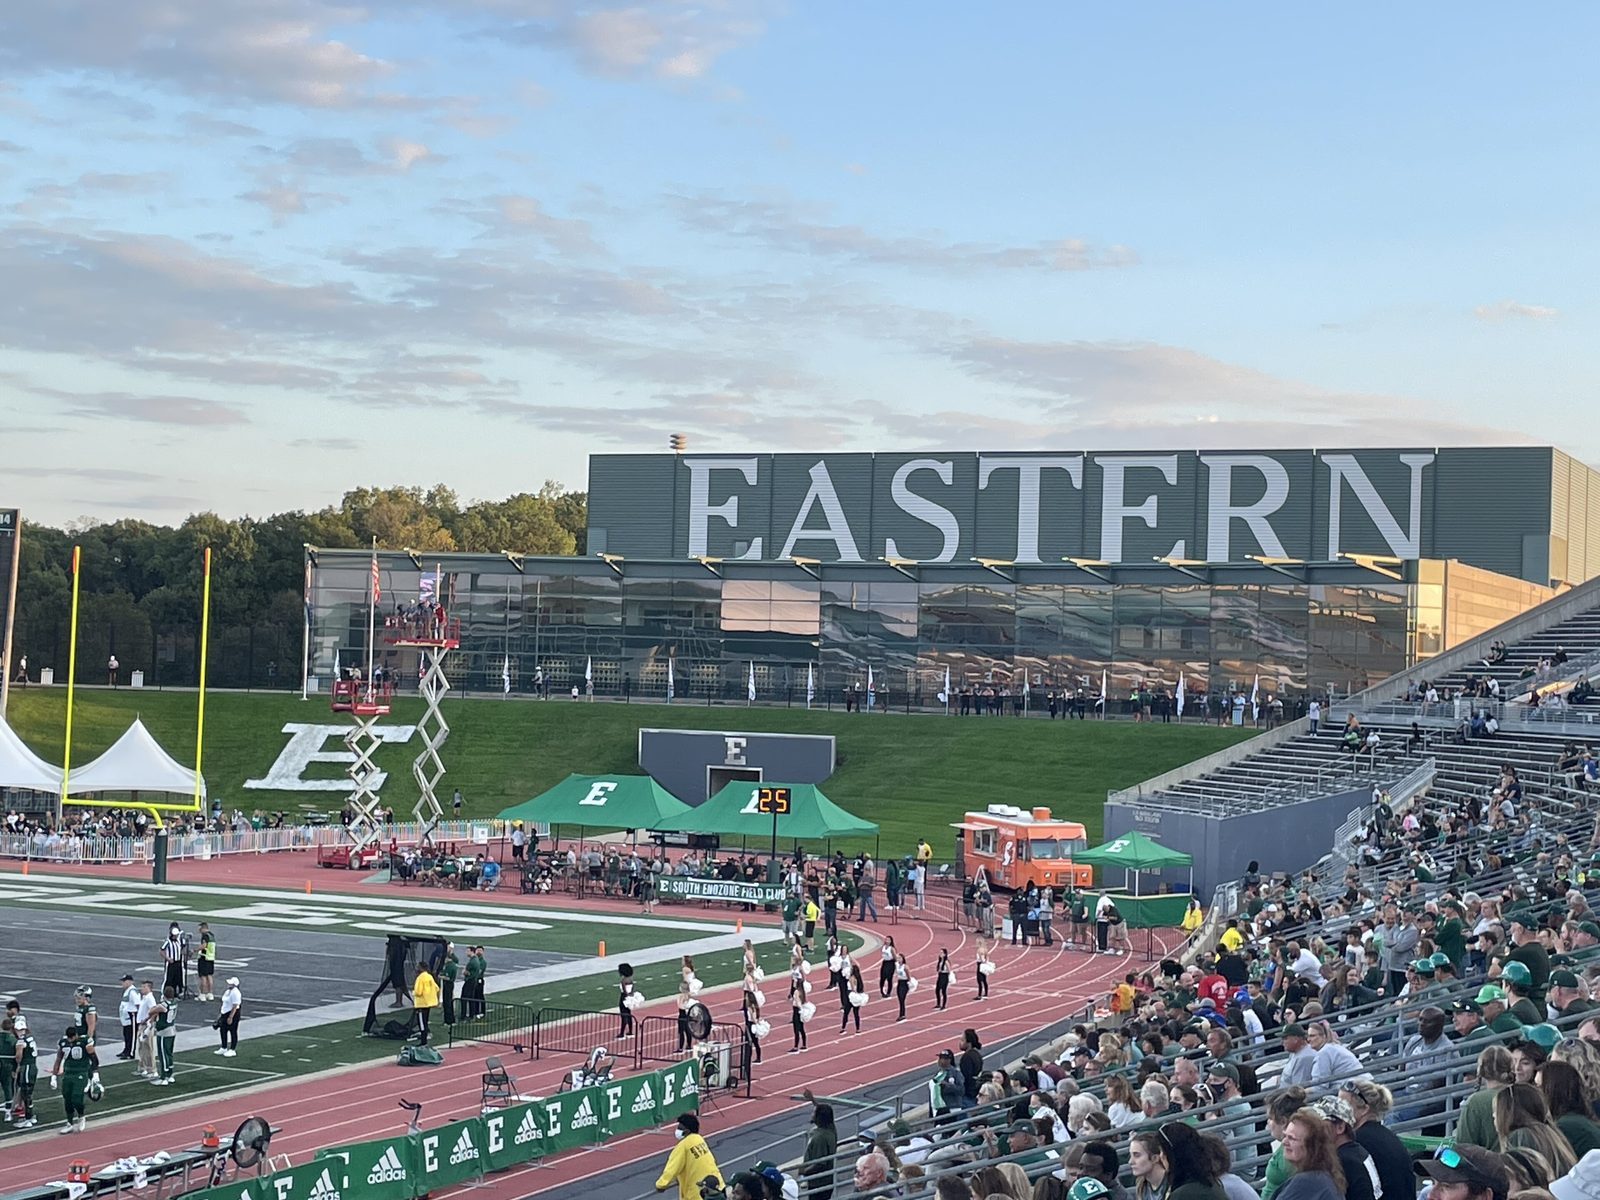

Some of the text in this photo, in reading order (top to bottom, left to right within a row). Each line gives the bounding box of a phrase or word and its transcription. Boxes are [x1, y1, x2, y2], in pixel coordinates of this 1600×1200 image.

[683, 453, 1435, 563] EASTERN
[243, 722, 416, 791] E
[724, 737, 747, 765] E
[578, 782, 618, 806] E
[759, 789, 787, 812] 25
[1104, 839, 1131, 853] E
[659, 879, 787, 900] E SOUTH ENDZONE FIELD CLUB
[62, 1046, 83, 1061] 70
[607, 1086, 656, 1121] E adidas
[663, 1073, 699, 1107] E adidas
[546, 1101, 598, 1137] E adidas
[487, 1116, 543, 1154] E adidas
[423, 1135, 480, 1173] E adidas
[367, 1168, 406, 1185] adidas
